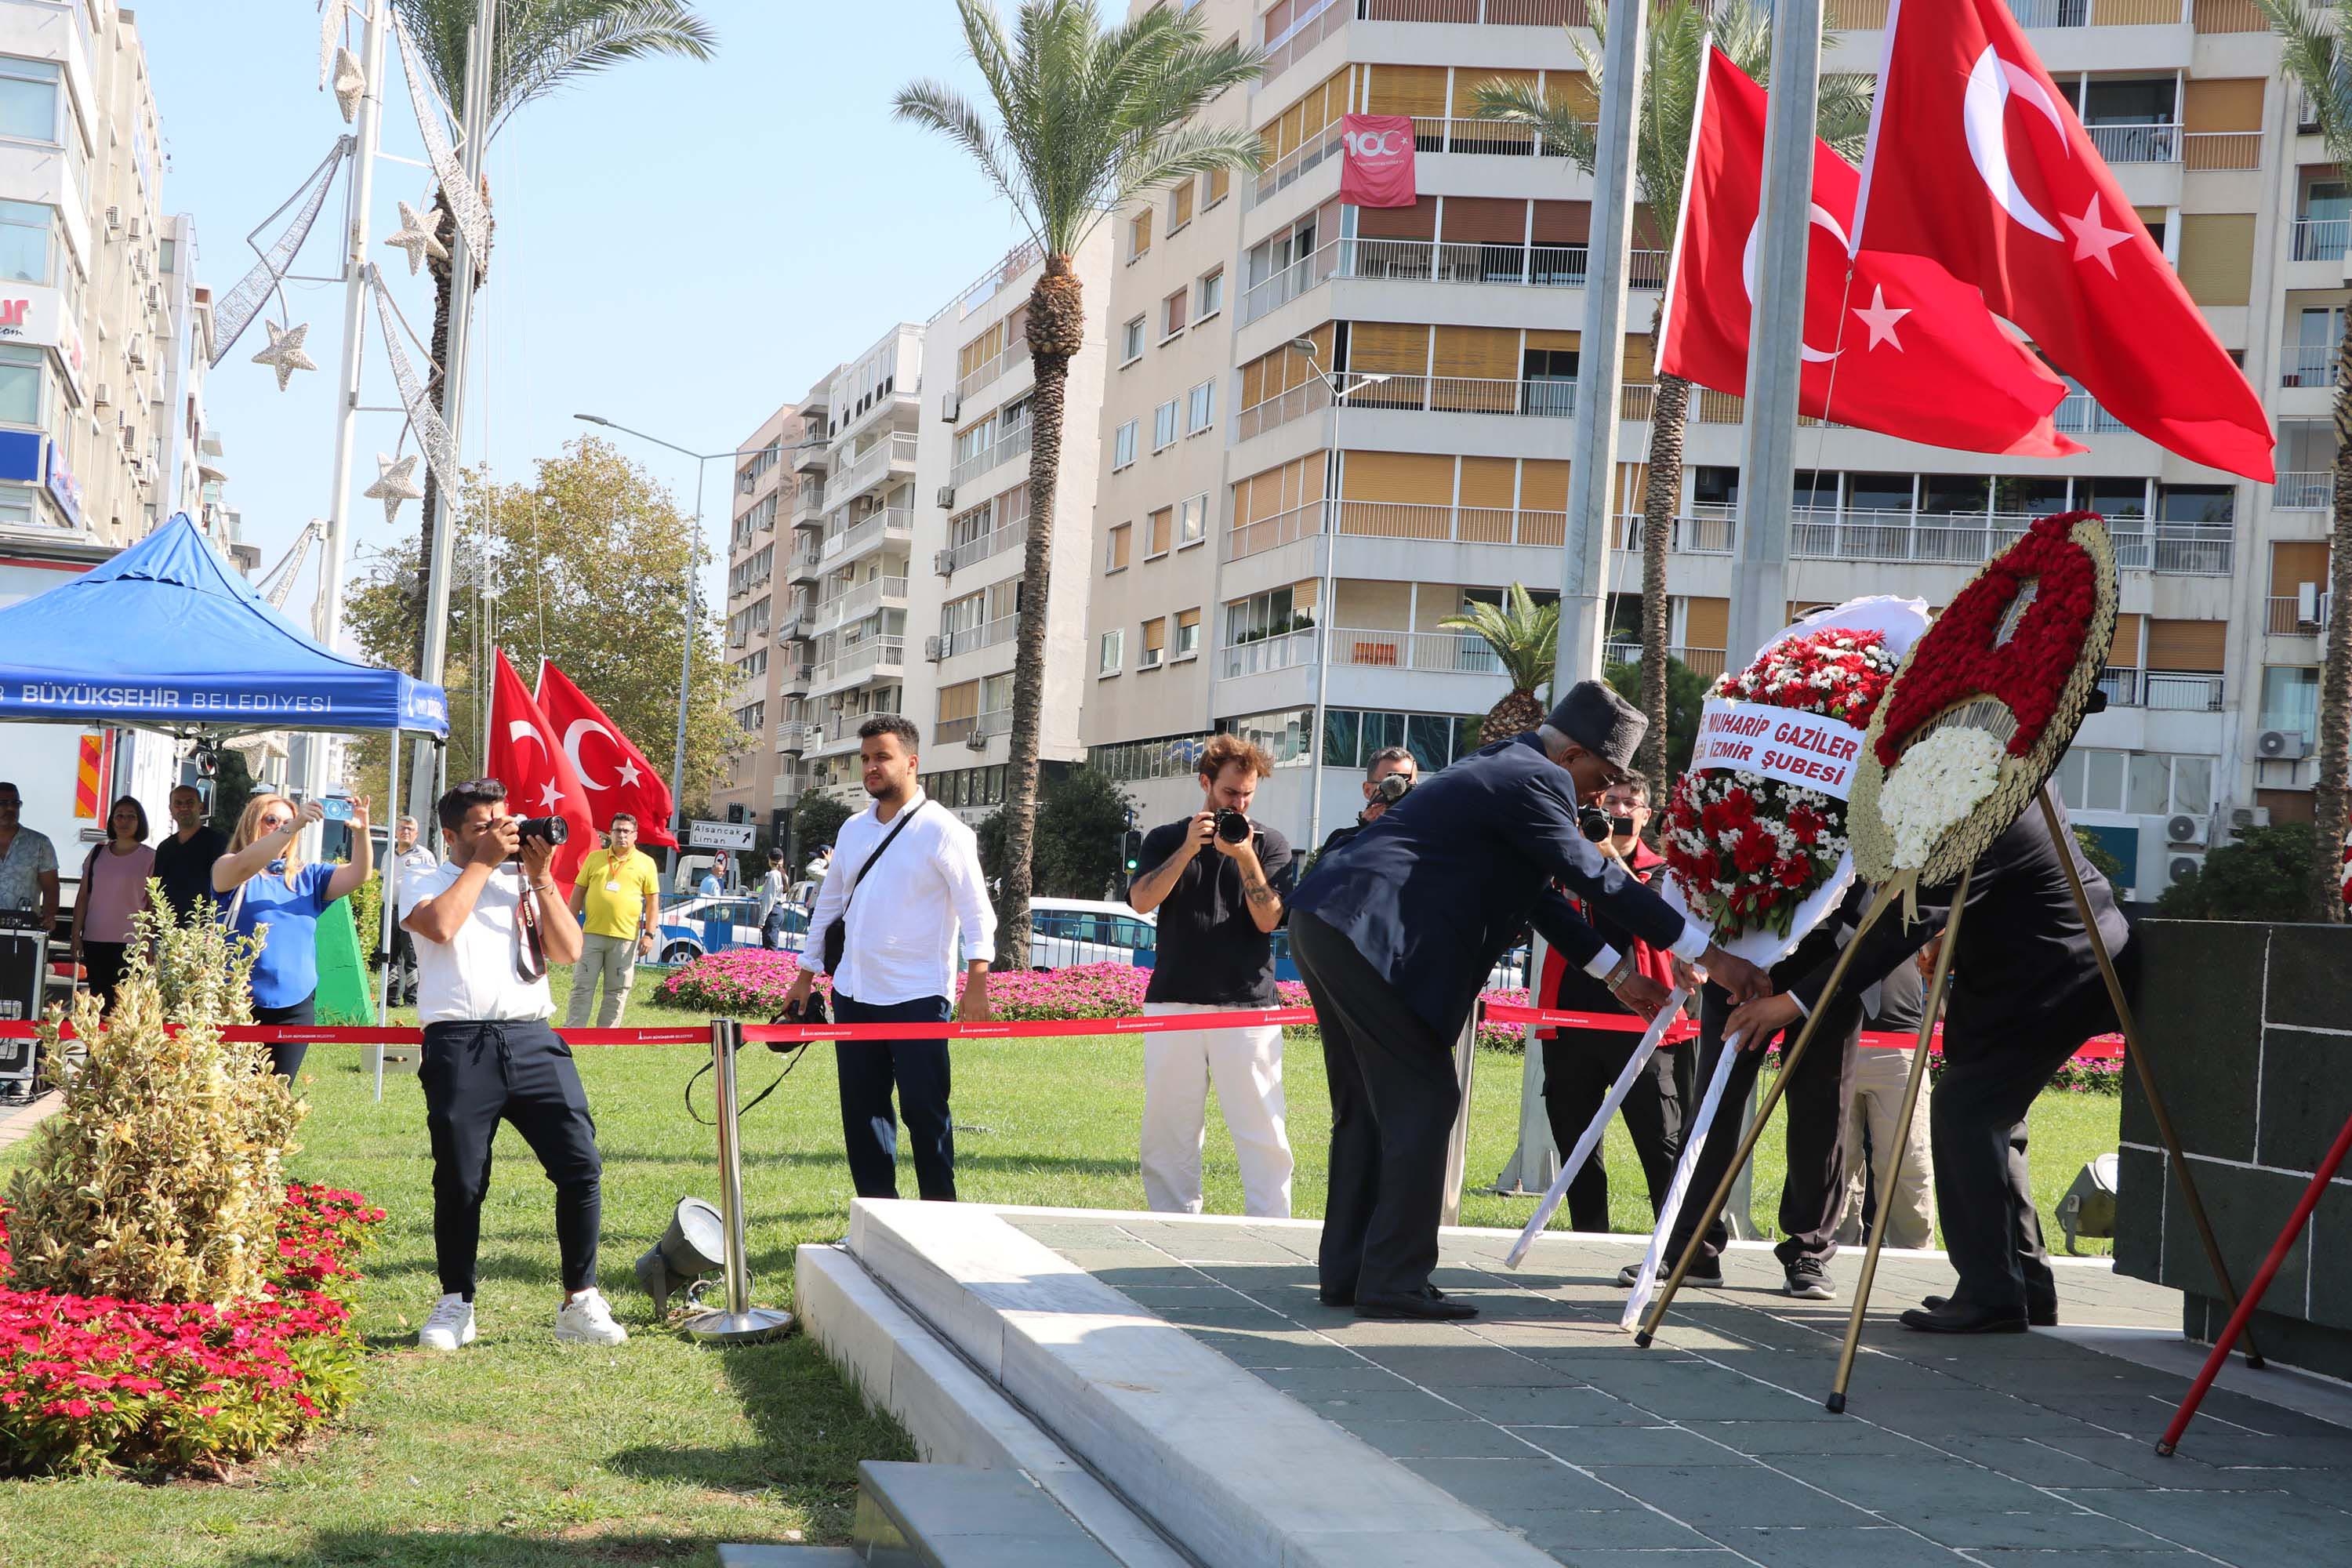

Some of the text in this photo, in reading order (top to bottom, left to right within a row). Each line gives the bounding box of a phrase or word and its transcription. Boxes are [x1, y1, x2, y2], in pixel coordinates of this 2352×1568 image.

[22, 681, 180, 708] BÜYÜKŞEHİR
[192, 693, 332, 712] BELEDİYESİ
[1708, 713, 1770, 738] MUHARİP
[1774, 723, 1858, 761] GAZİLER
[1709, 739, 1753, 761] İZMİR
[1761, 750, 1846, 785] ŞUBESİ
[694, 835, 726, 844] Liman
[695, 825, 741, 836] Alsancak
[523, 901, 534, 927] Canon
